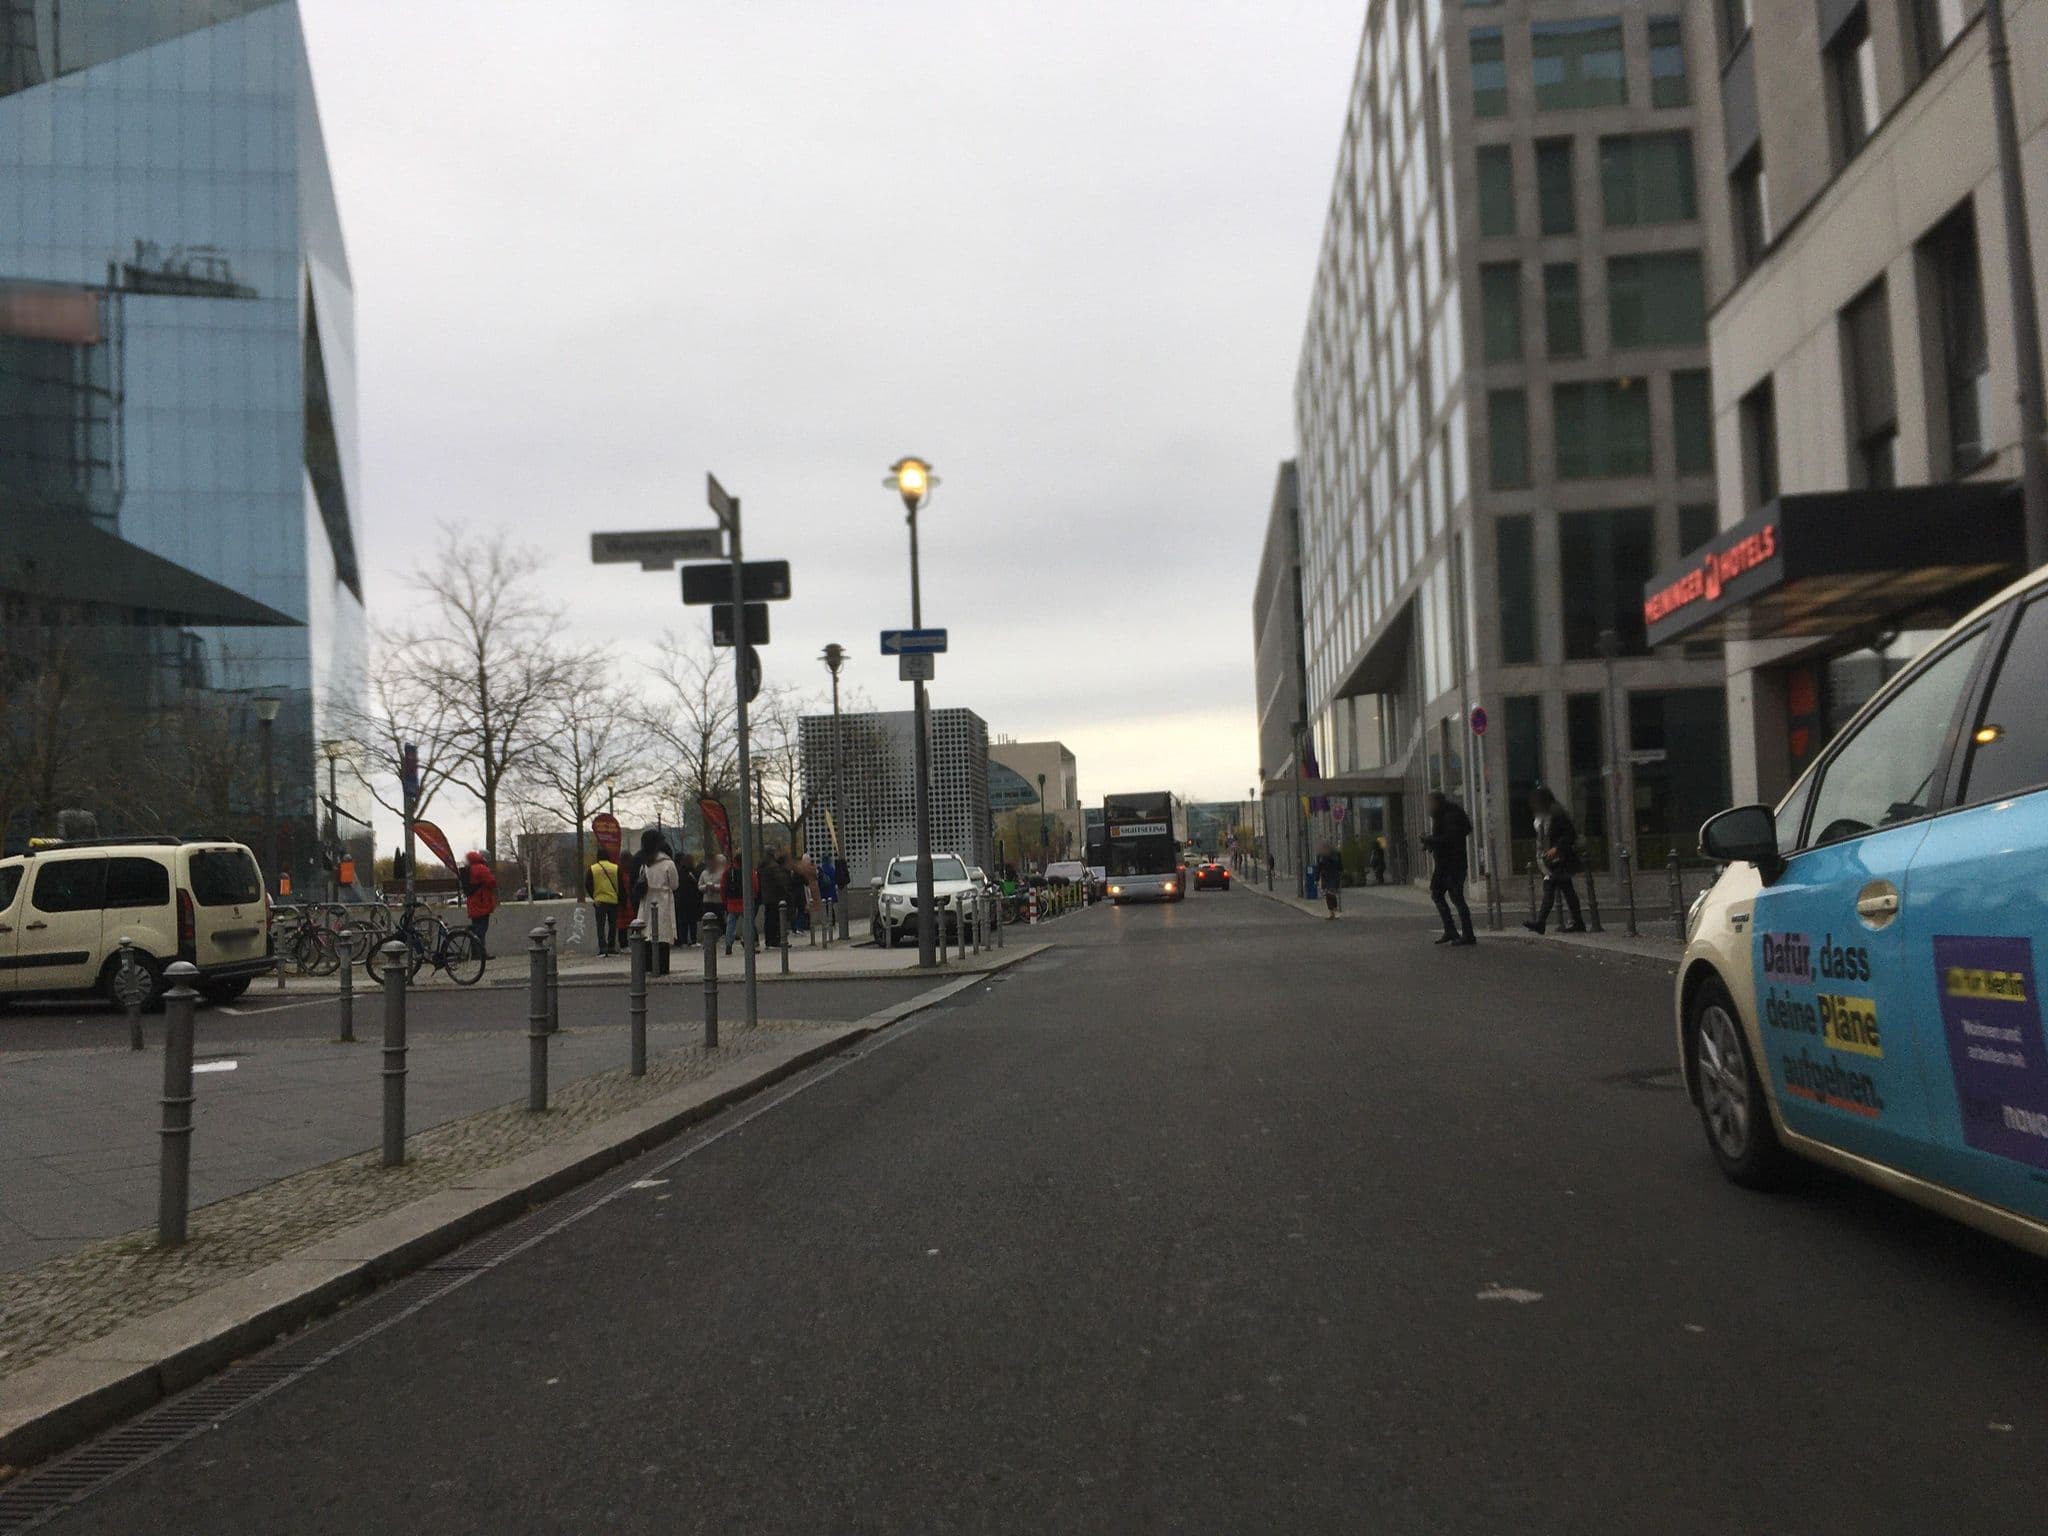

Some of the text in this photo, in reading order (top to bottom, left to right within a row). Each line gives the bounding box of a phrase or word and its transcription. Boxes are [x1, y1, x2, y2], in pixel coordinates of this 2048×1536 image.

[1720, 524, 1776, 584] HOTELS
[1120, 826, 1165, 834] SIGHTSEEING
[1763, 933, 1871, 982] Dafür, dass
[1766, 987, 1880, 1048] deine Pläne
